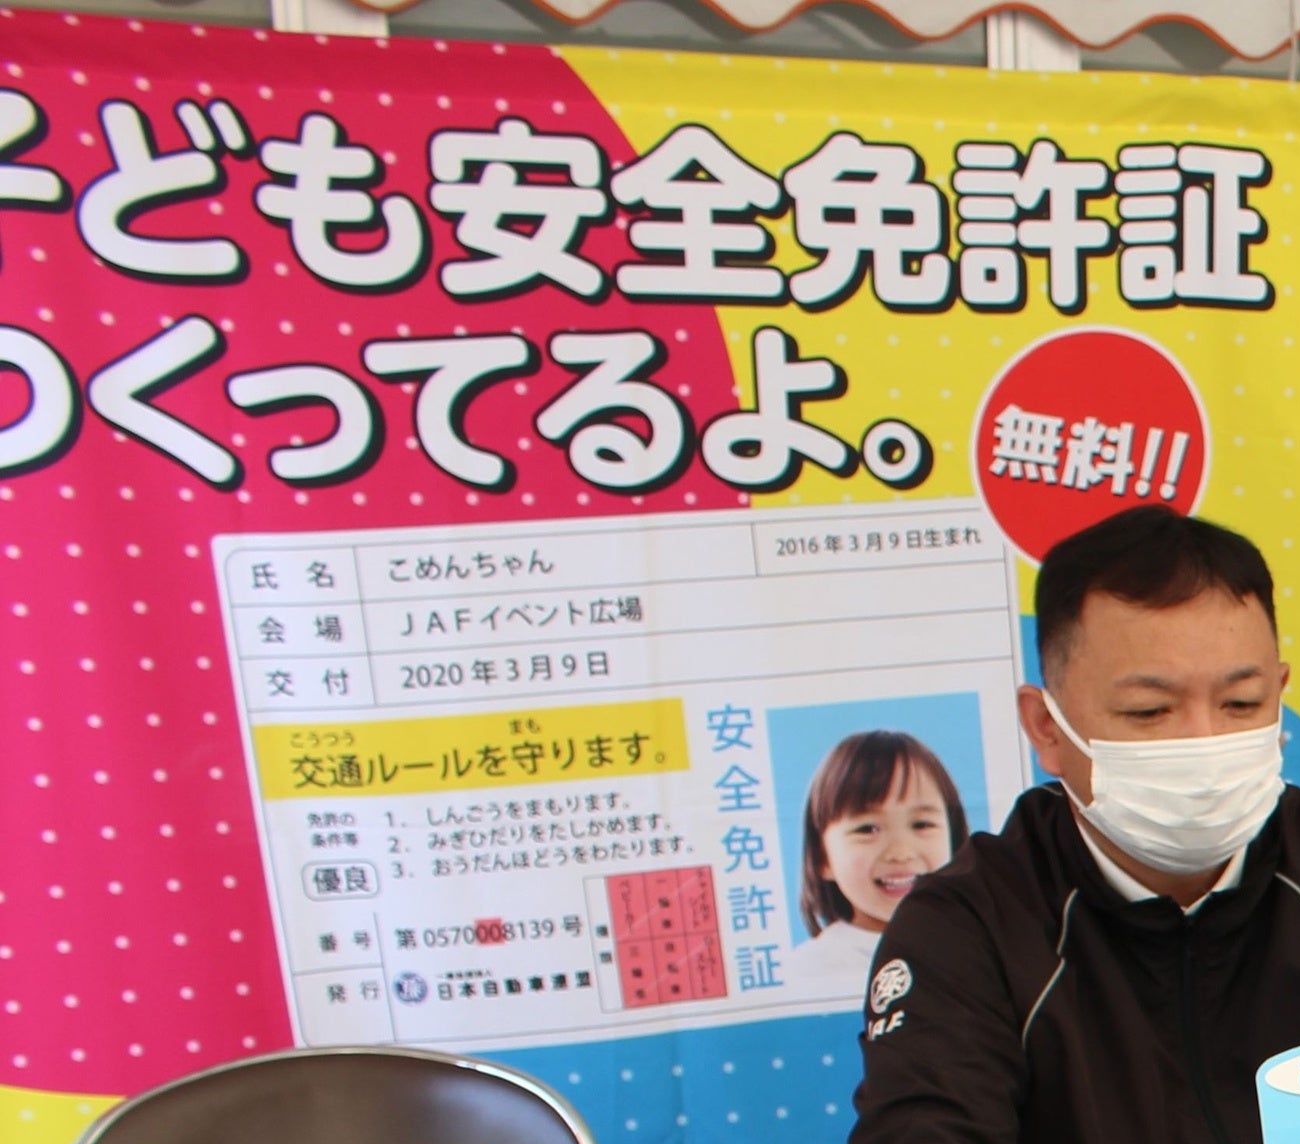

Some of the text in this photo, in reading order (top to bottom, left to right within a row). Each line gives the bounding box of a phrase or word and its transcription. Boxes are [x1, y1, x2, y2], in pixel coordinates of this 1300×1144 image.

[775, 526, 982, 556] 2016年3月9日生まれ
[387, 550, 554, 583] こめんちゃん
[401, 597, 642, 637] JAFイベント広場
[401, 650, 610, 690] 2020年3月9日
[292, 730, 667, 790] 交通ルールを守ります。
[707, 704, 783, 993] 安全免許証
[313, 867, 369, 893] 優良
